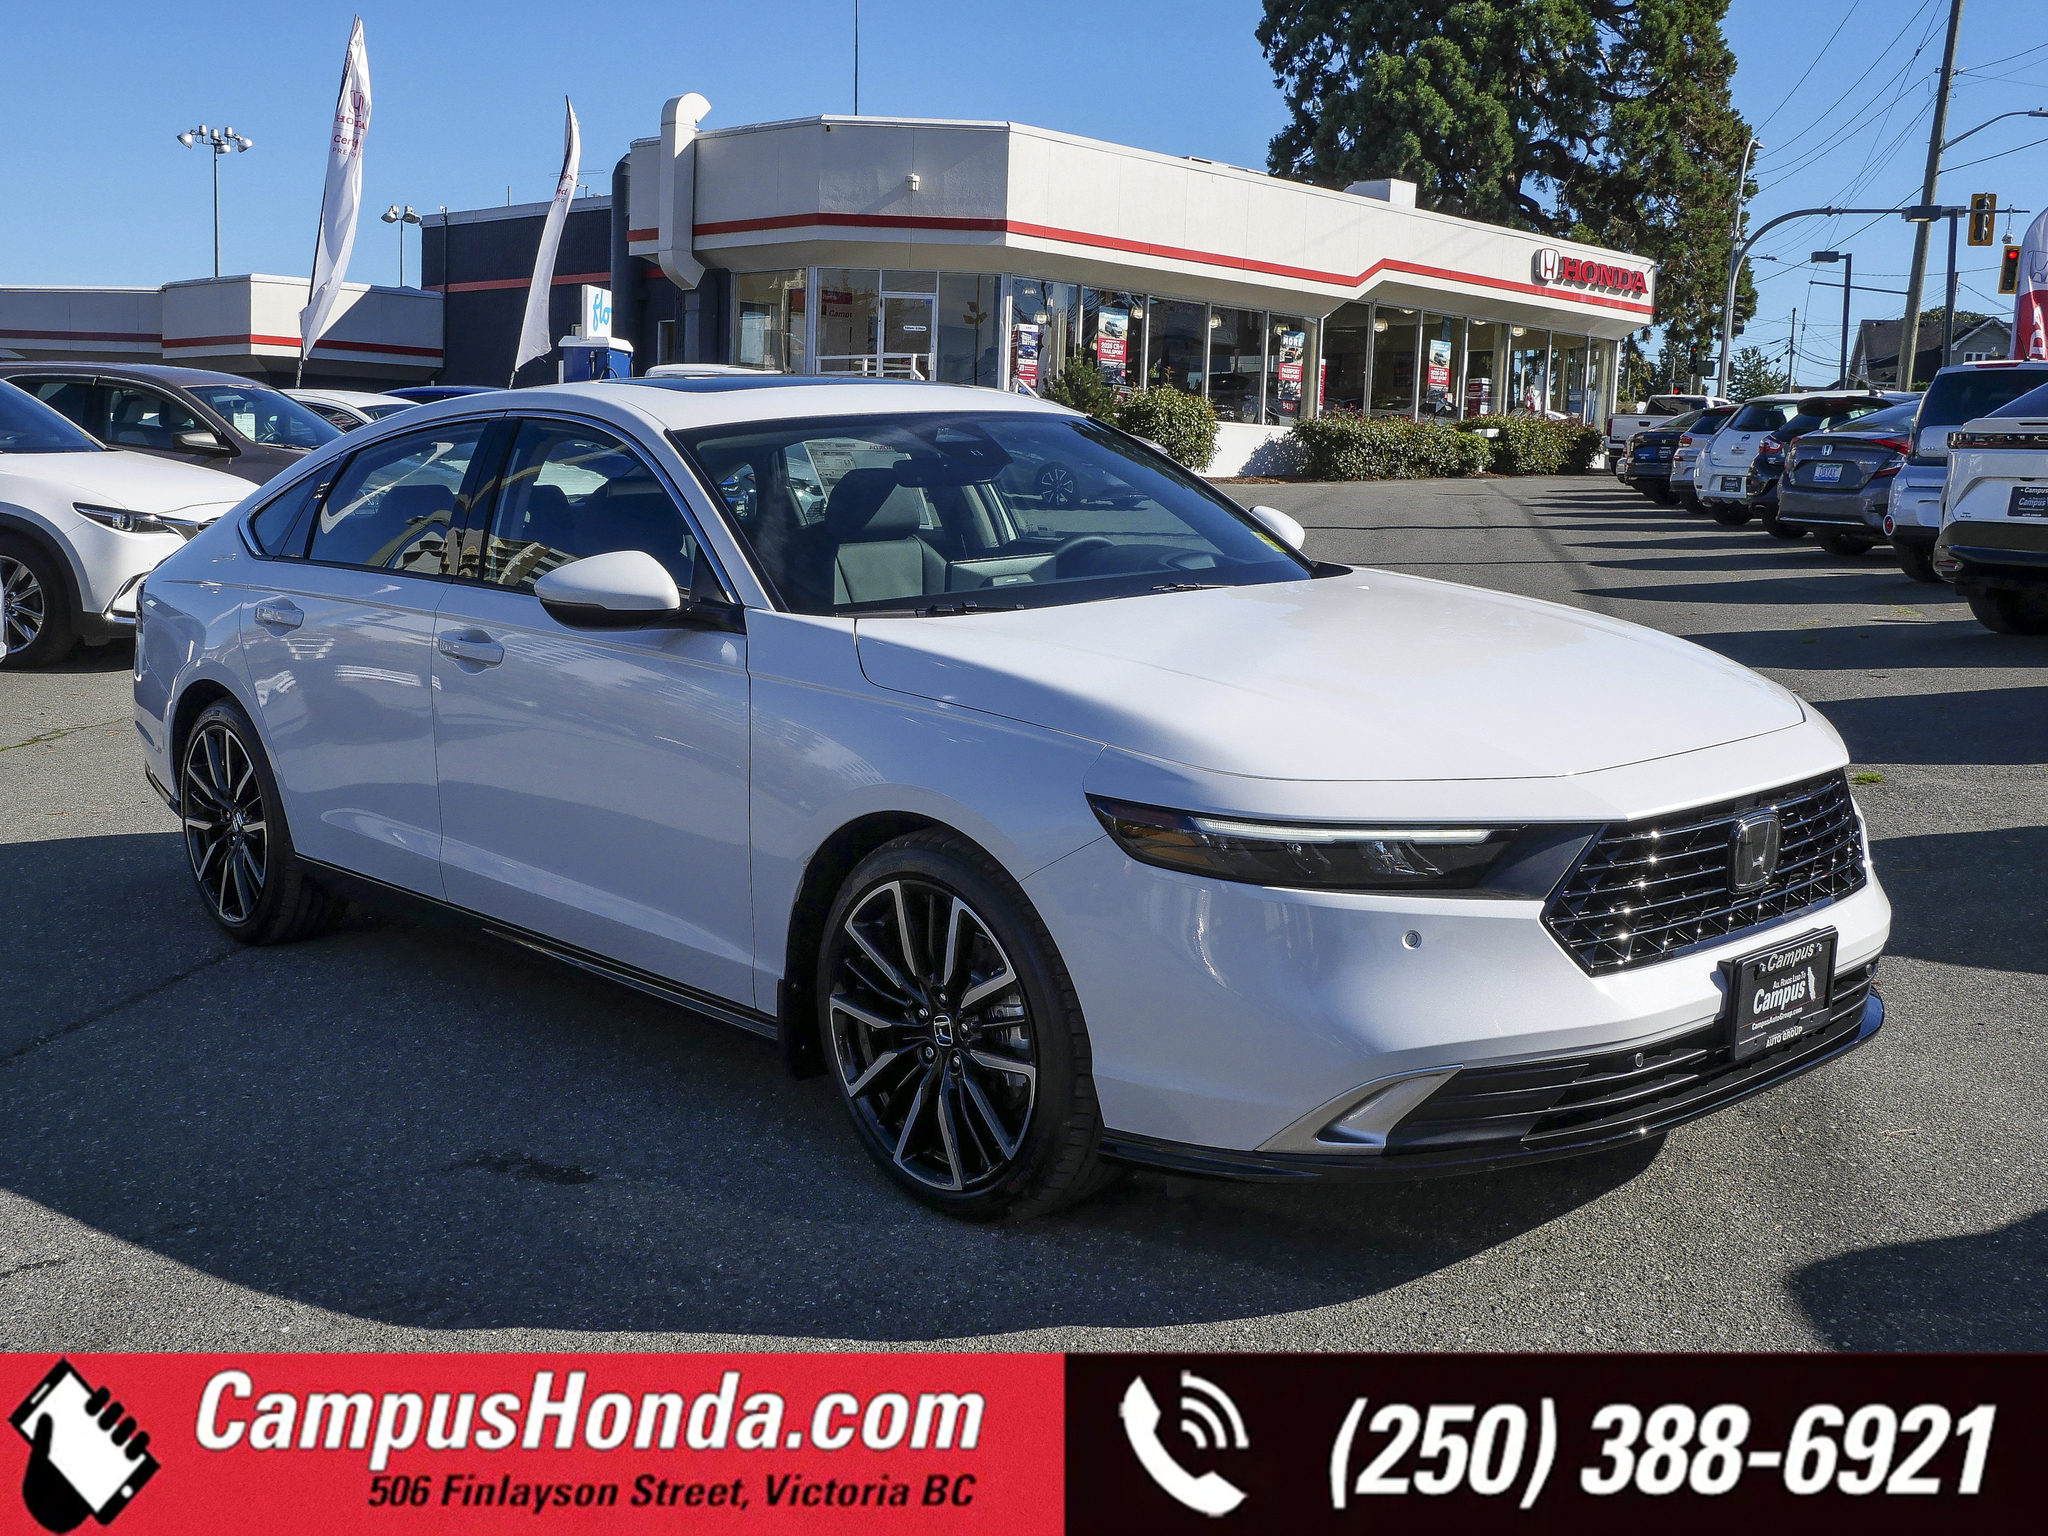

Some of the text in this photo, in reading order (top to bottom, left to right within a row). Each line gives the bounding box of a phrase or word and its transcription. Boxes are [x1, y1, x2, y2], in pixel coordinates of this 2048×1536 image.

[1561, 257, 1648, 294] HONDA
[593, 290, 613, 331] flo
[1282, 336, 1303, 347] MORE
[2018, 497, 2046, 508] Campus
[2024, 487, 2048, 495] Campus
[1767, 943, 1815, 971] Campus
[1753, 980, 1806, 1014] Campus
[1751, 1007, 1803, 1031] CampusAutoGroup.com
[1765, 1026, 1803, 1048] AUTO GROUP
